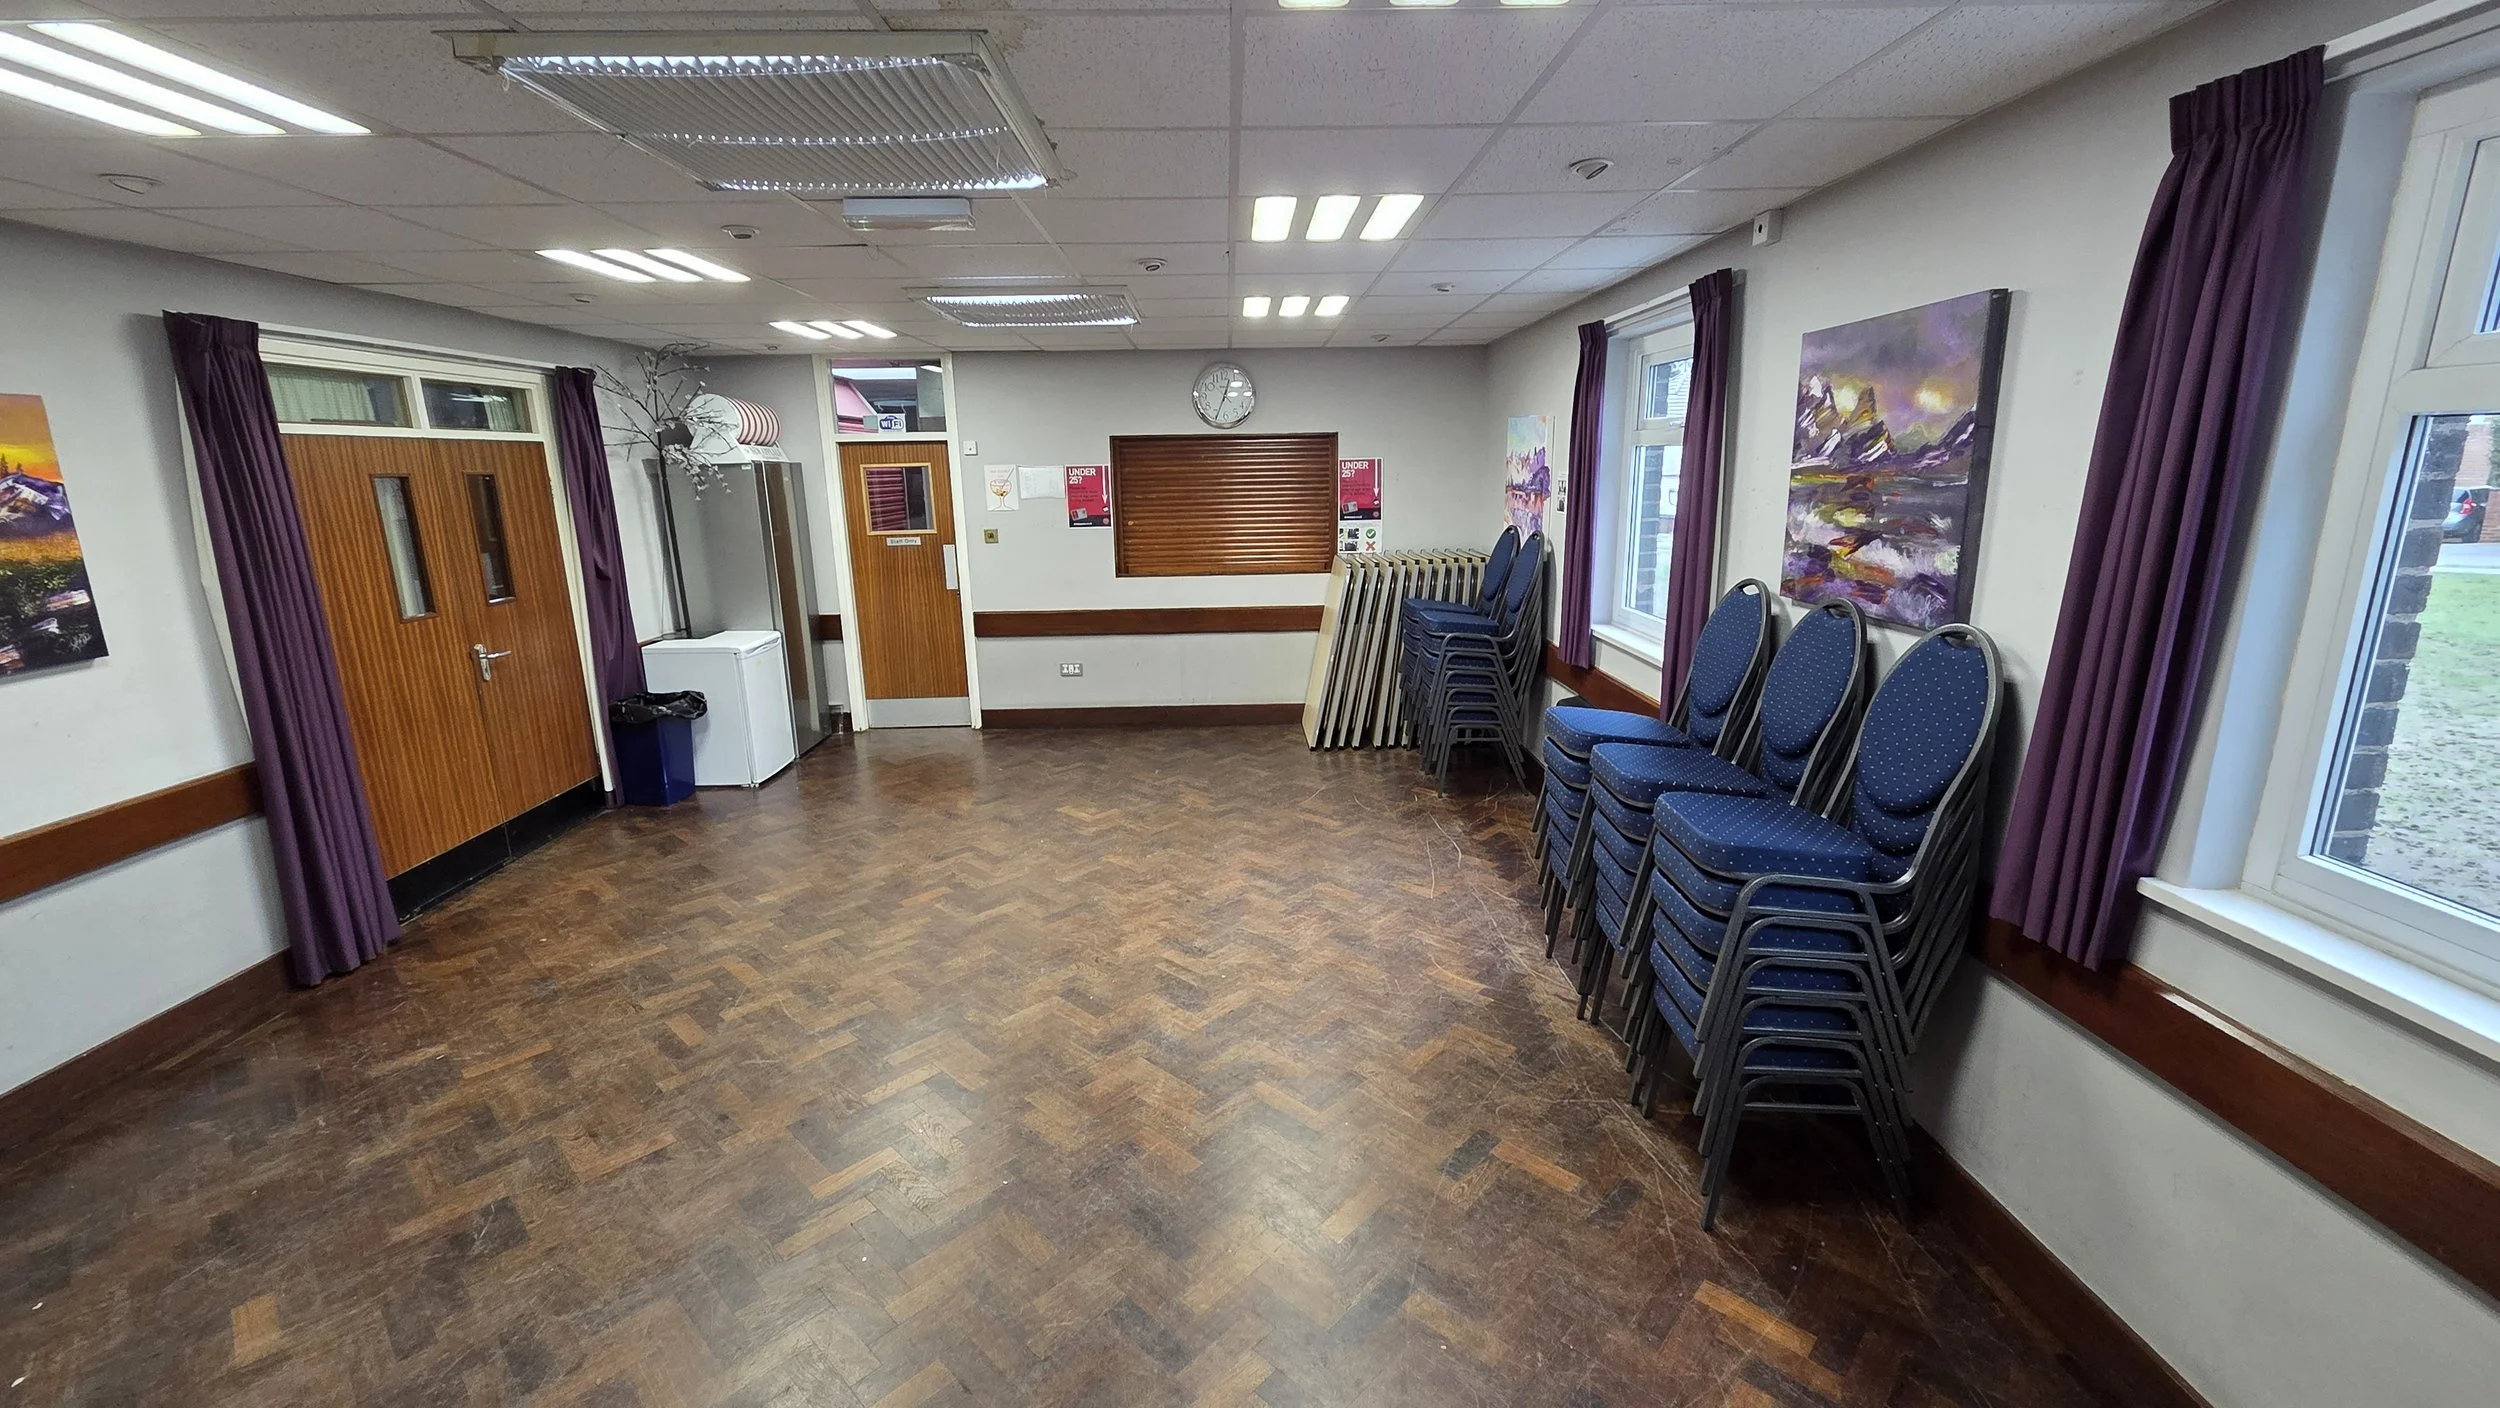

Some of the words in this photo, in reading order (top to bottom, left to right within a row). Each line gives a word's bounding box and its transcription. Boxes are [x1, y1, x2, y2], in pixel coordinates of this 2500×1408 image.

[1341, 461, 1369, 470] UNDER
[1068, 467, 1097, 476] UNDER
[1341, 469, 1356, 478] 25?
[1068, 476, 1083, 485] 25?
